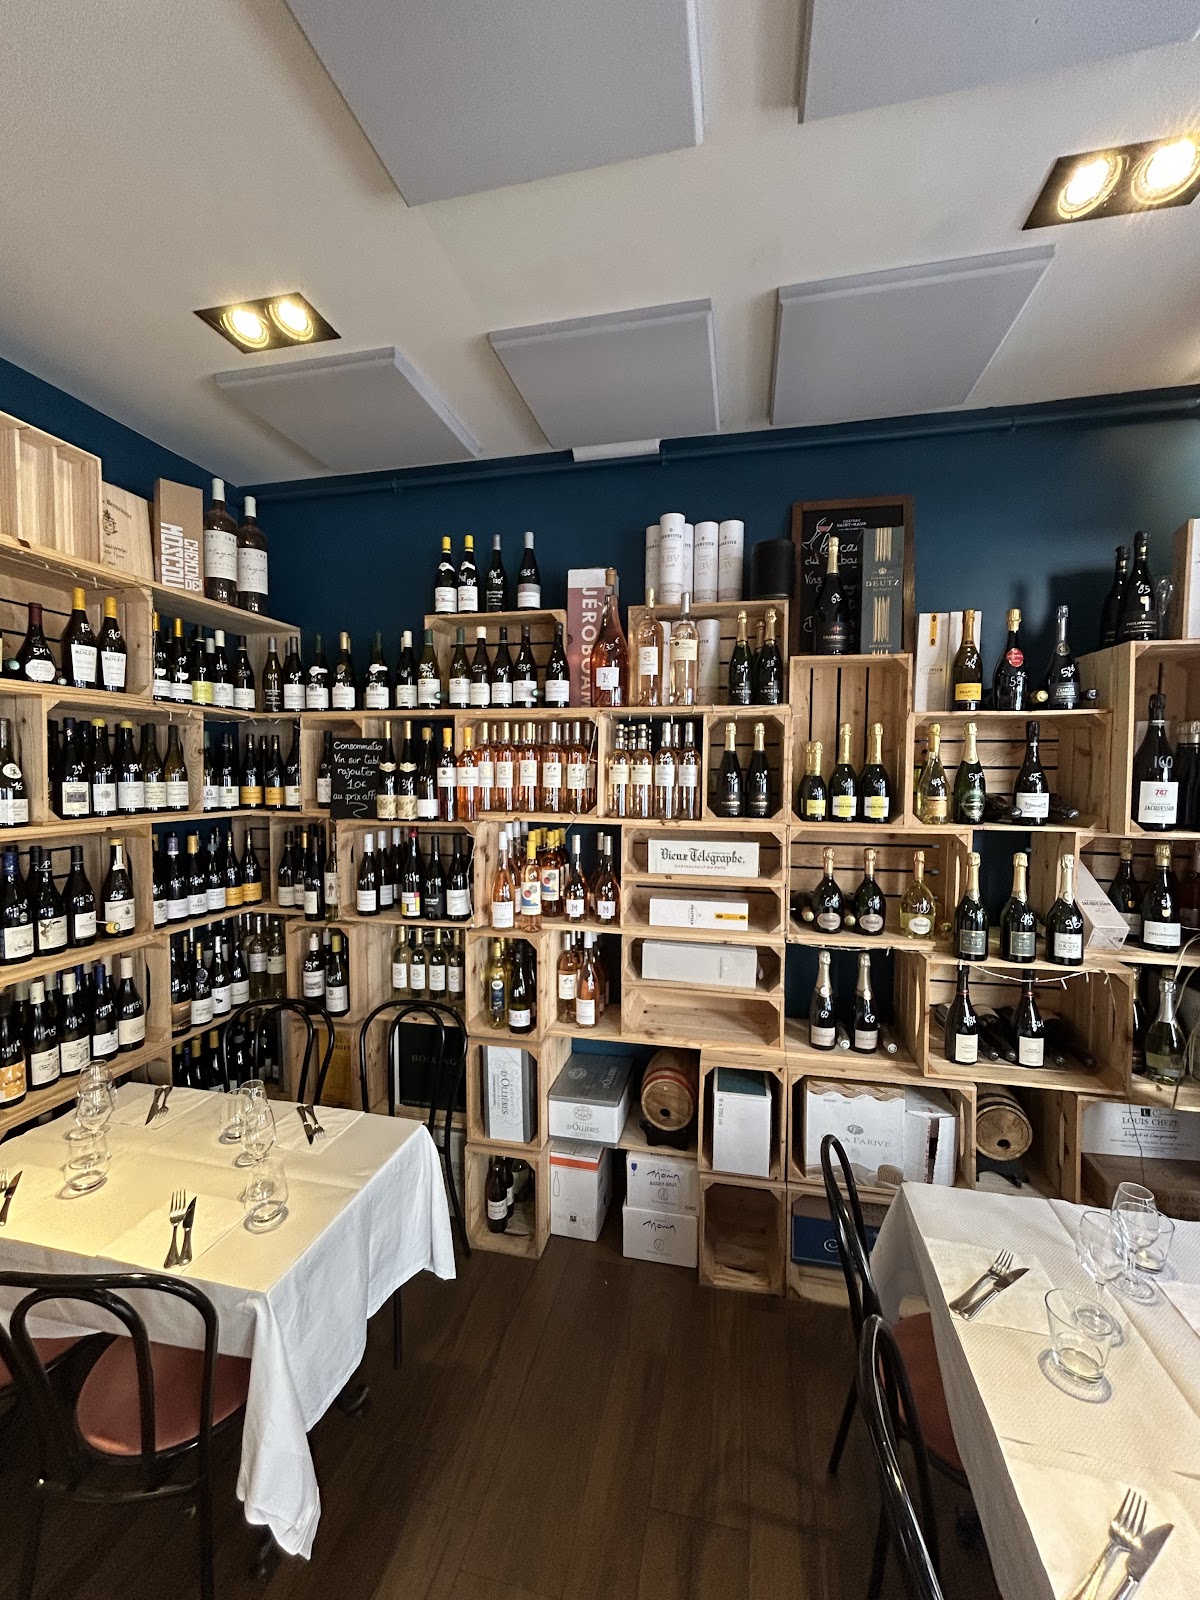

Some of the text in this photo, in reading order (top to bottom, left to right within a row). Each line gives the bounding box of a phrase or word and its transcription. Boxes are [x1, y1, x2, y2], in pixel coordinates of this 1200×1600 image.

[160, 521, 185, 589] MOSCOU
[865, 579, 900, 587] DEUTZ
[333, 753, 380, 765] Vin sur tabl
[337, 766, 377, 780] rajouter
[332, 792, 343, 801] au
[345, 790, 361, 805] prix
[1154, 788, 1168, 797] 747
[660, 847, 689, 861] Vieux
[1122, 1116, 1149, 1125] LOUIS
